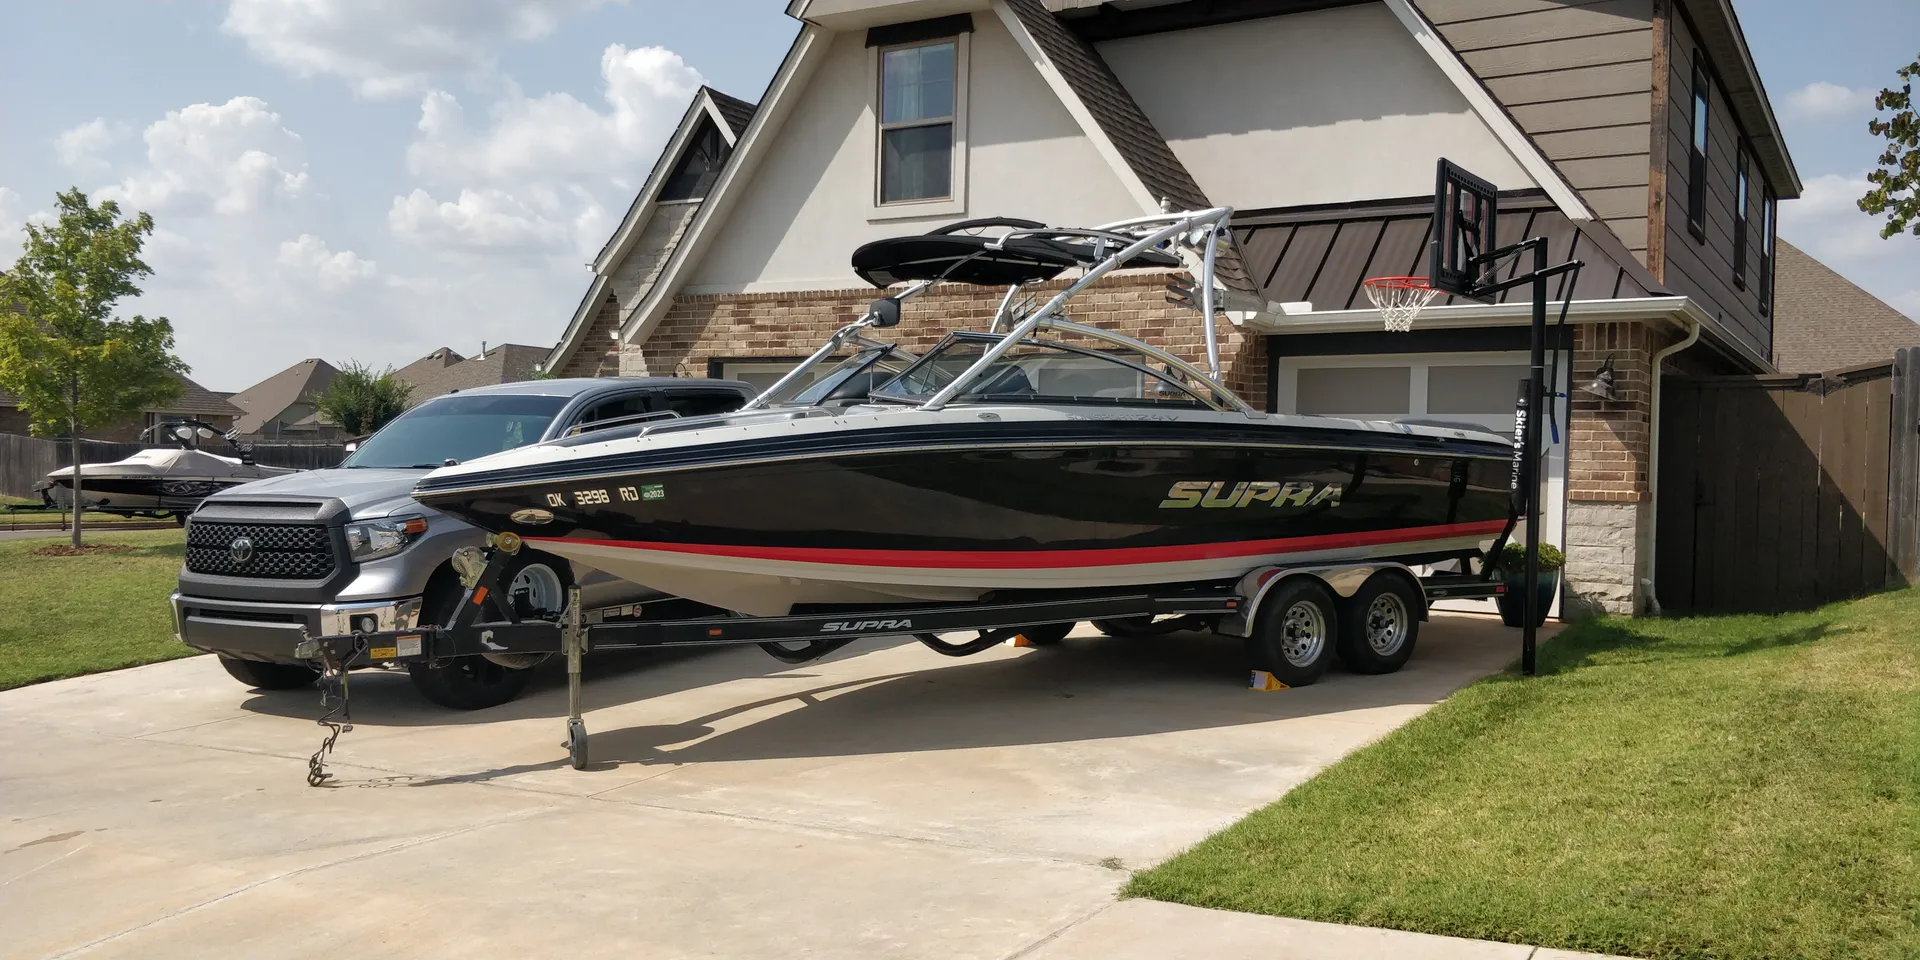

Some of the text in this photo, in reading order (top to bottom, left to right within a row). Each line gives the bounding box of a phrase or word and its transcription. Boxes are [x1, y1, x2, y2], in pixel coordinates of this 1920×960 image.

[1510, 409, 1528, 489] Skier's Marine
[546, 486, 639, 507] OK 3298 RD
[649, 489, 665, 498] 2023
[1158, 481, 1342, 509] SUPRA
[820, 619, 912, 632] SUPRA
